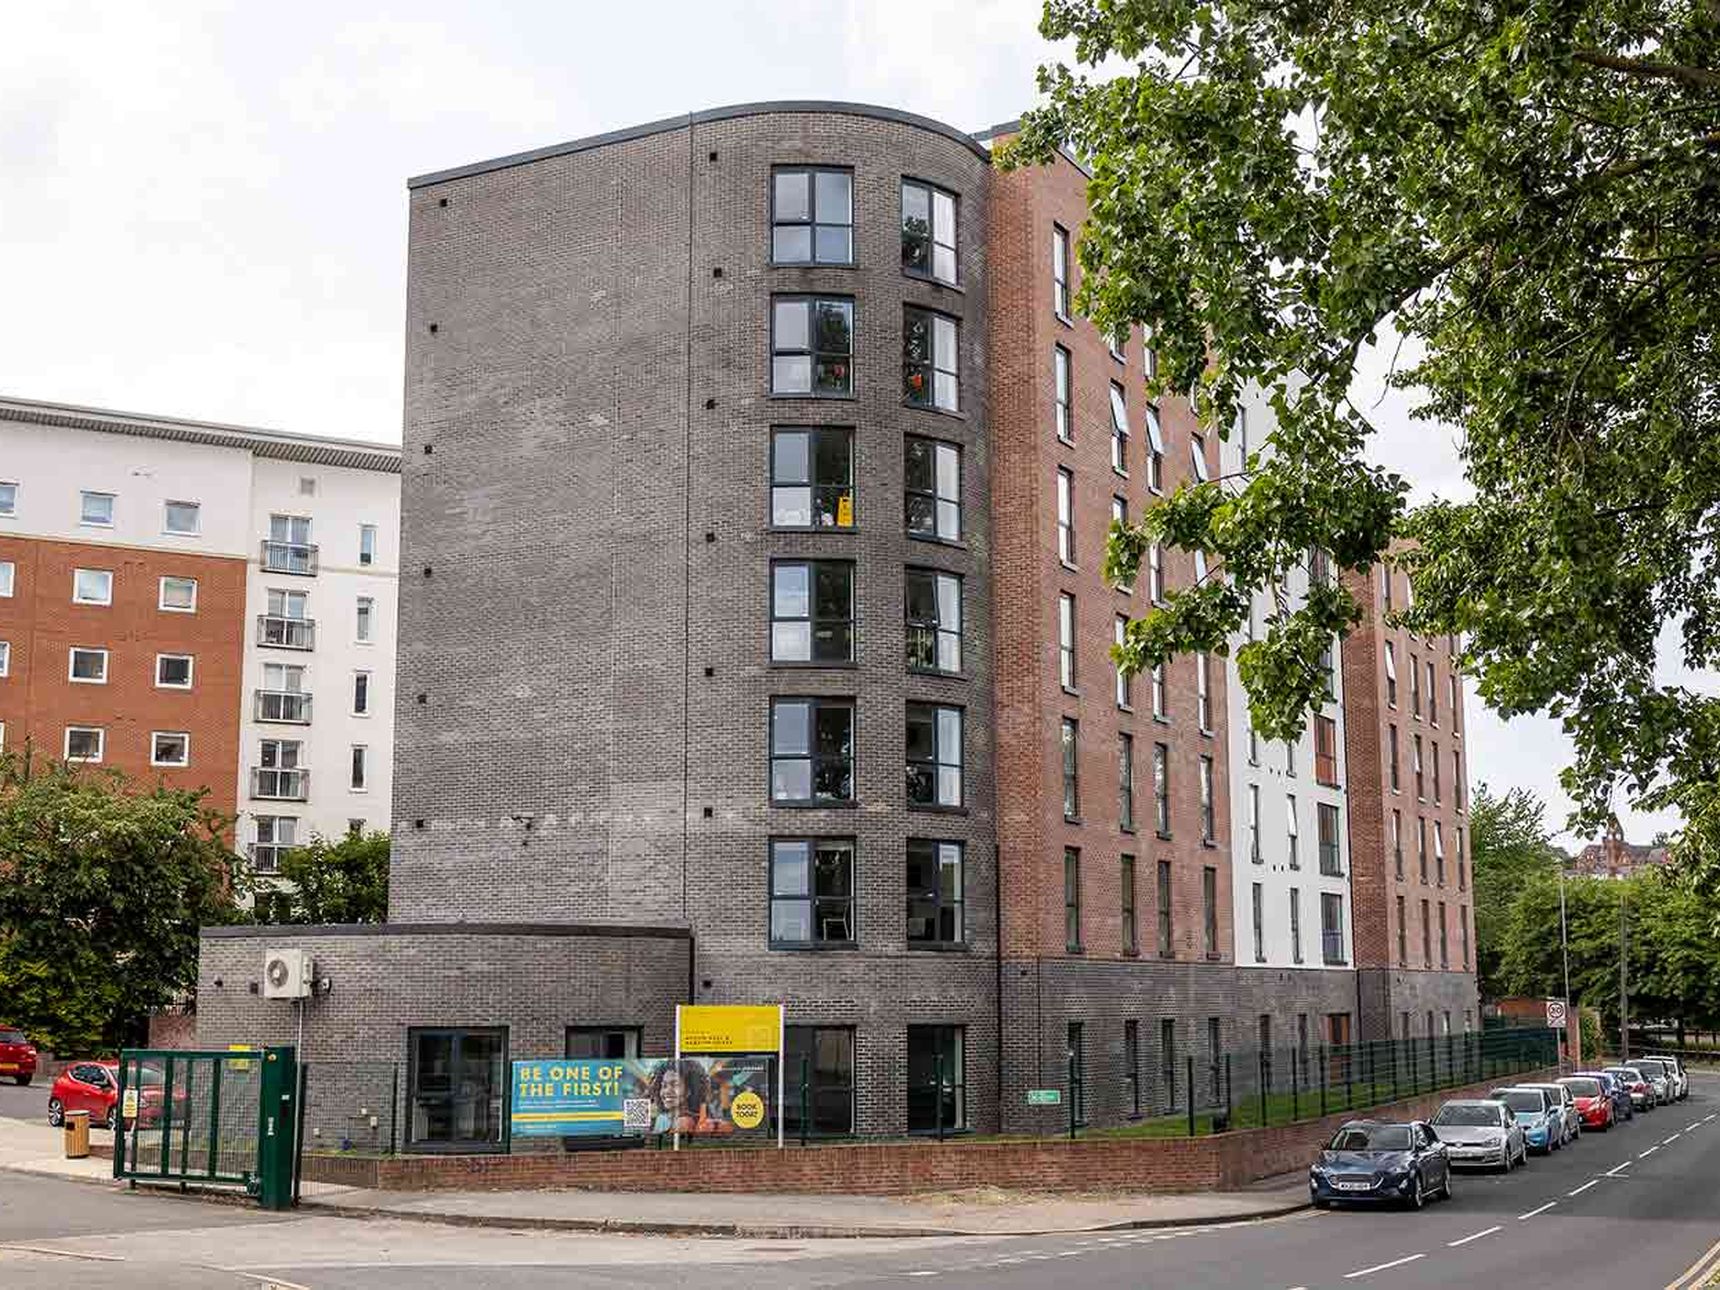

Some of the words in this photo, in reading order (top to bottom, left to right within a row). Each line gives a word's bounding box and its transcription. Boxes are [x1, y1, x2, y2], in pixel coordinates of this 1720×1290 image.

[520, 1067, 541, 1080] BE
[550, 1066, 590, 1080] ONE
[599, 1066, 623, 1080] OF
[519, 1083, 554, 1096] THE
[563, 1082, 619, 1096] FIRST!
